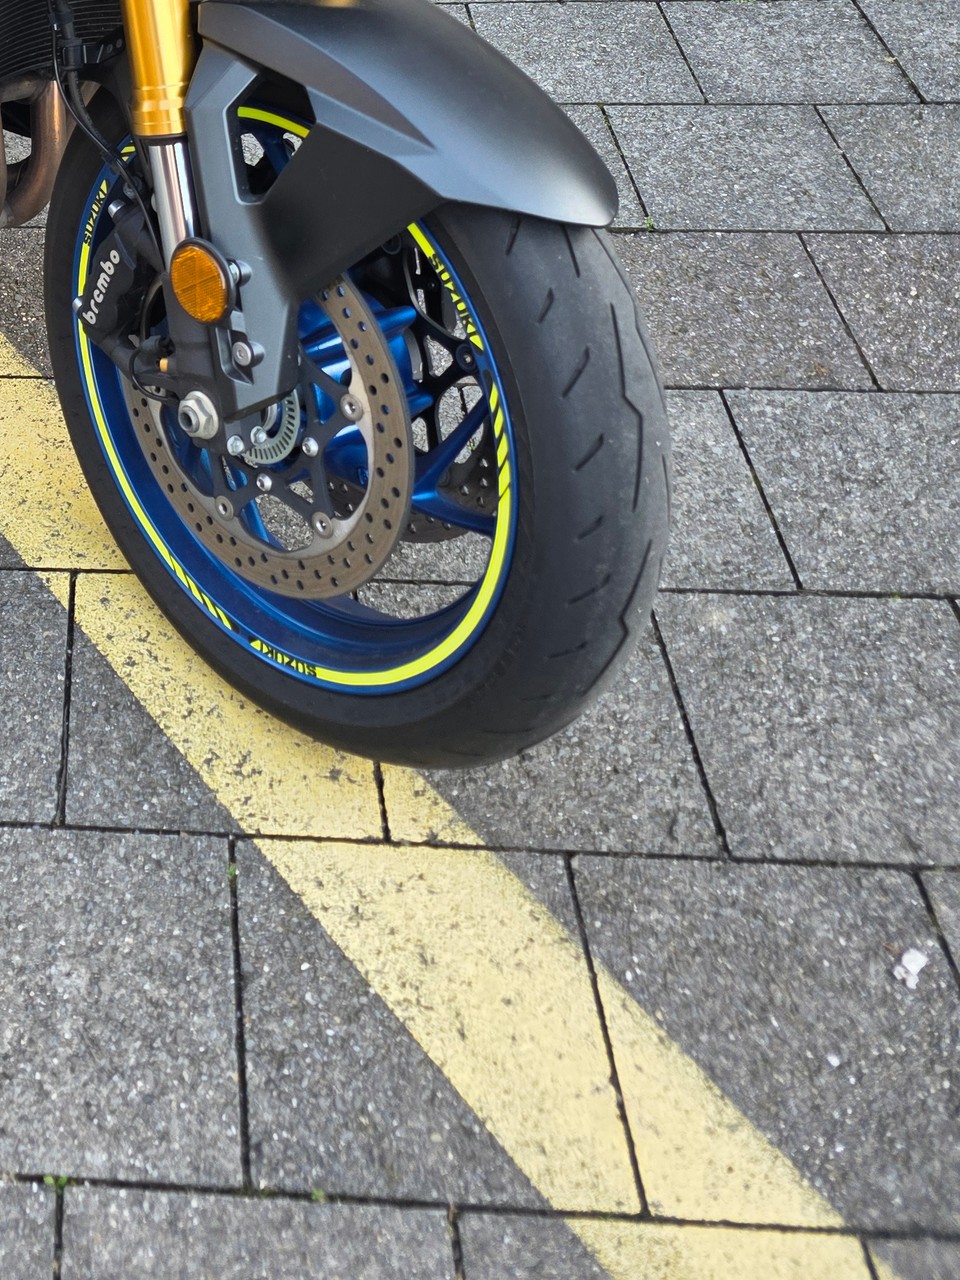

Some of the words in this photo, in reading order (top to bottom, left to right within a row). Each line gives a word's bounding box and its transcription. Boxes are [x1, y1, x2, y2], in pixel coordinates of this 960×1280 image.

[84, 185, 109, 247] SUZUKI
[430, 253, 478, 339] SUZUKI
[259, 641, 317, 678] SUZUKI
